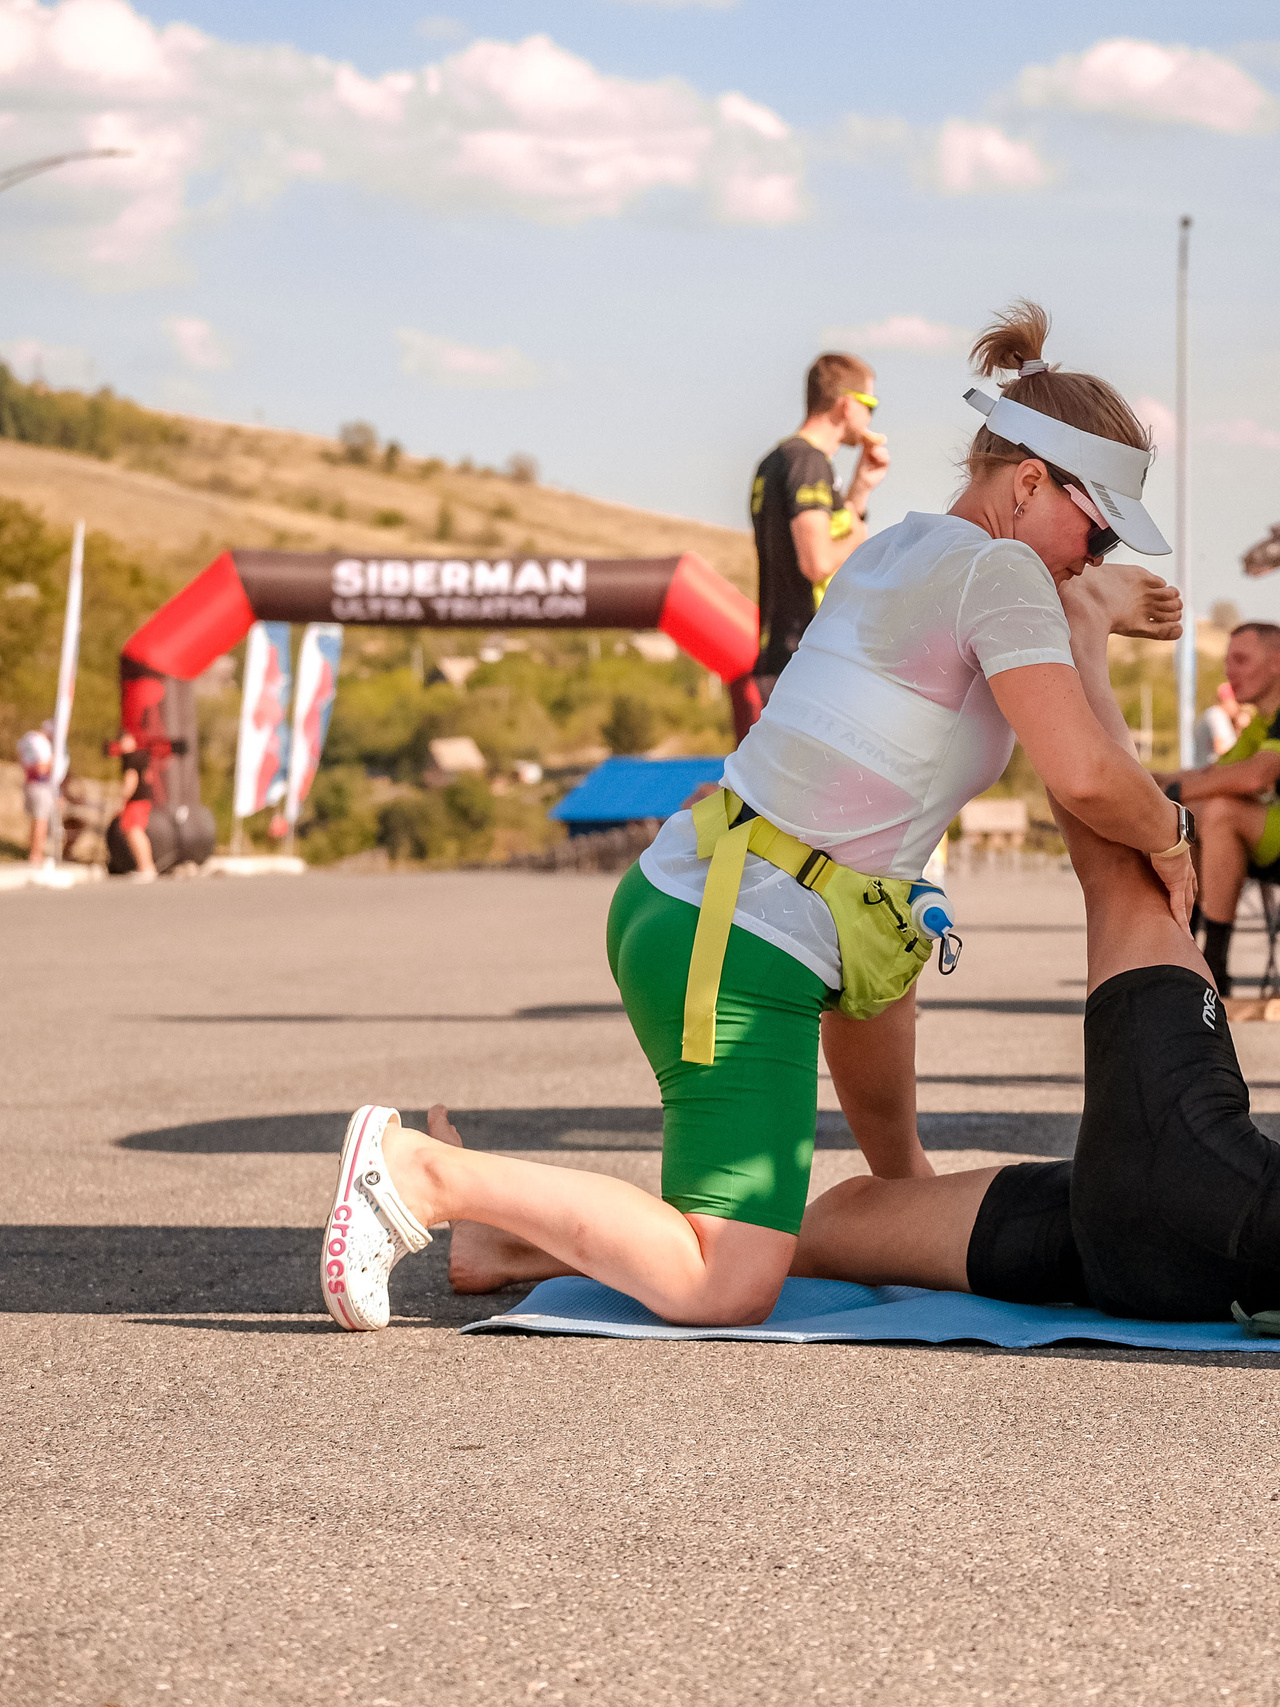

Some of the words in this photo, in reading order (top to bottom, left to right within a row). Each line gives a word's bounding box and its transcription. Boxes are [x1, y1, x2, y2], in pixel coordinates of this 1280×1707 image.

[332, 559, 587, 597] SIBERMAN
[331, 596, 424, 620] ULTRA
[326, 1204, 352, 1294] crocs
